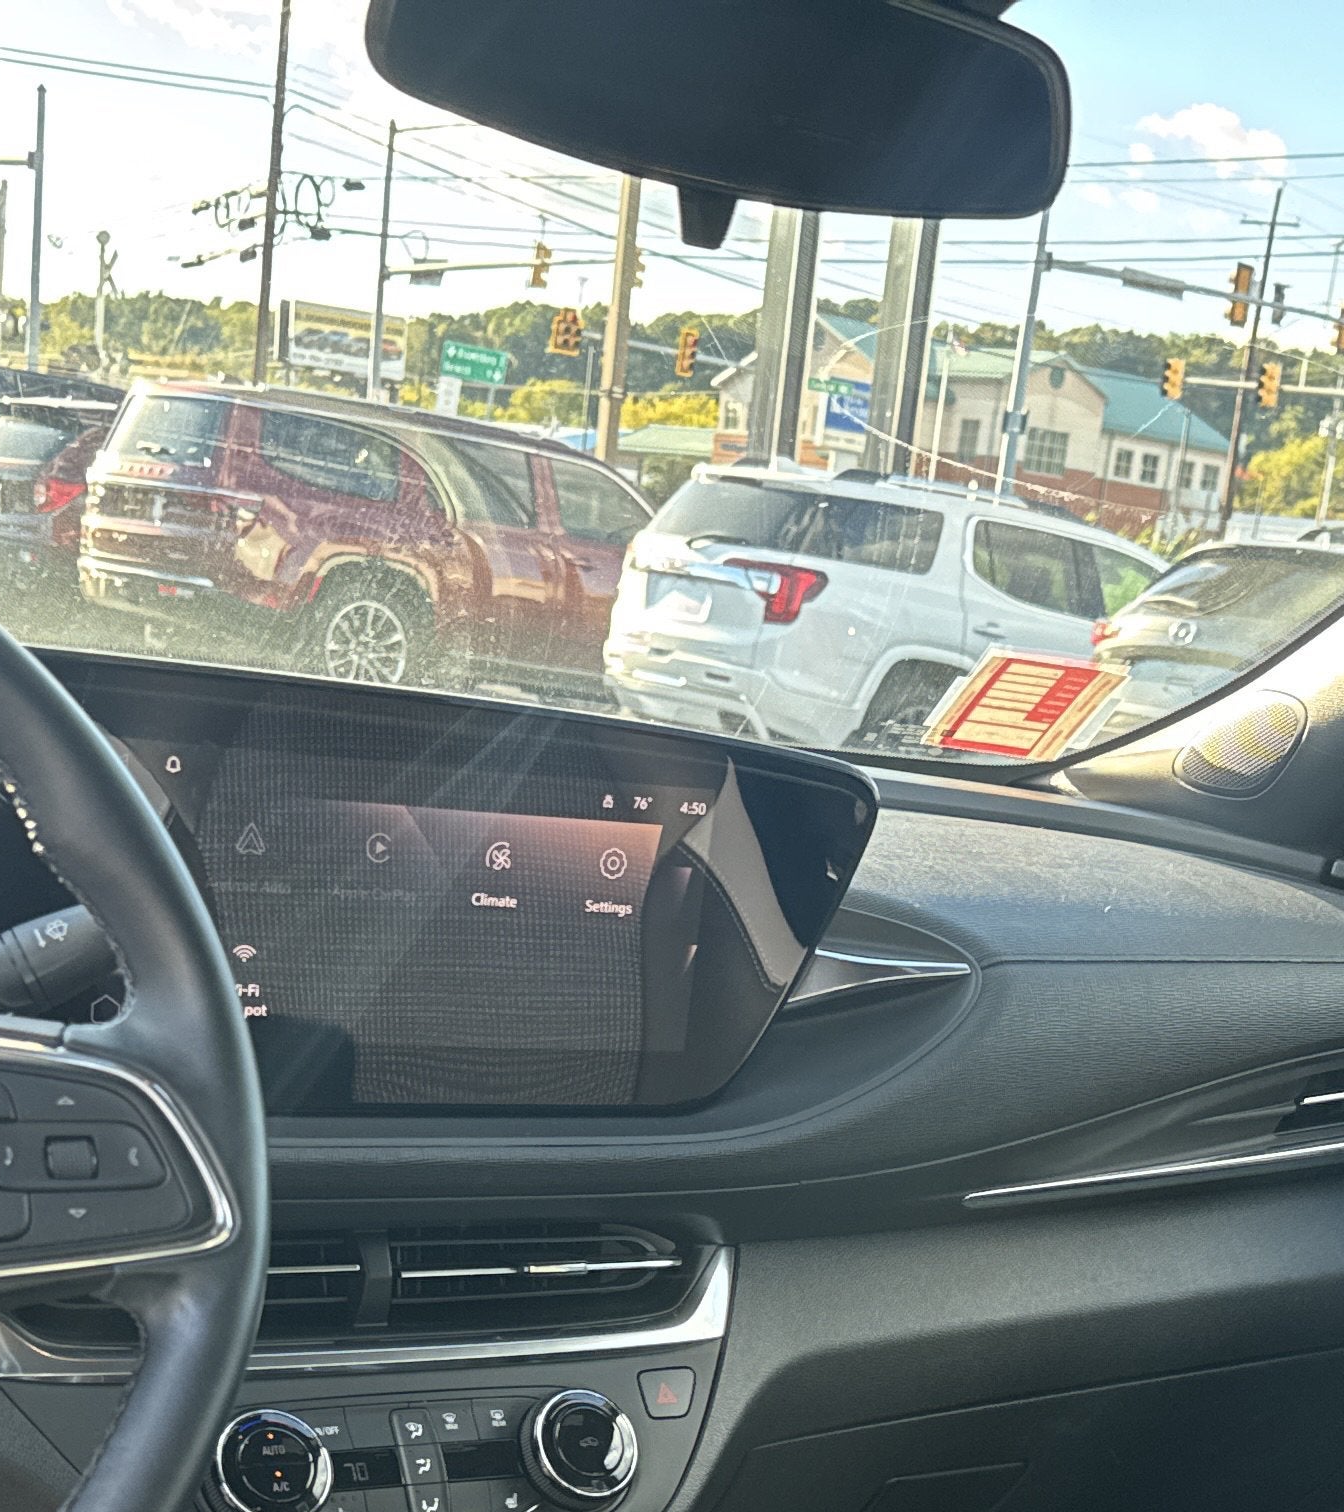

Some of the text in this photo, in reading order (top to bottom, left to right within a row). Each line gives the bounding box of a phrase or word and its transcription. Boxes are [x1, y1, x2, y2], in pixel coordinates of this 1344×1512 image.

[679, 801, 707, 816] 4:50
[471, 892, 518, 909] Climate
[584, 898, 633, 917] Settings
[261, 1445, 286, 1457] AUTO
[343, 1462, 370, 1482] 70
[272, 1481, 291, 1493] A/C
